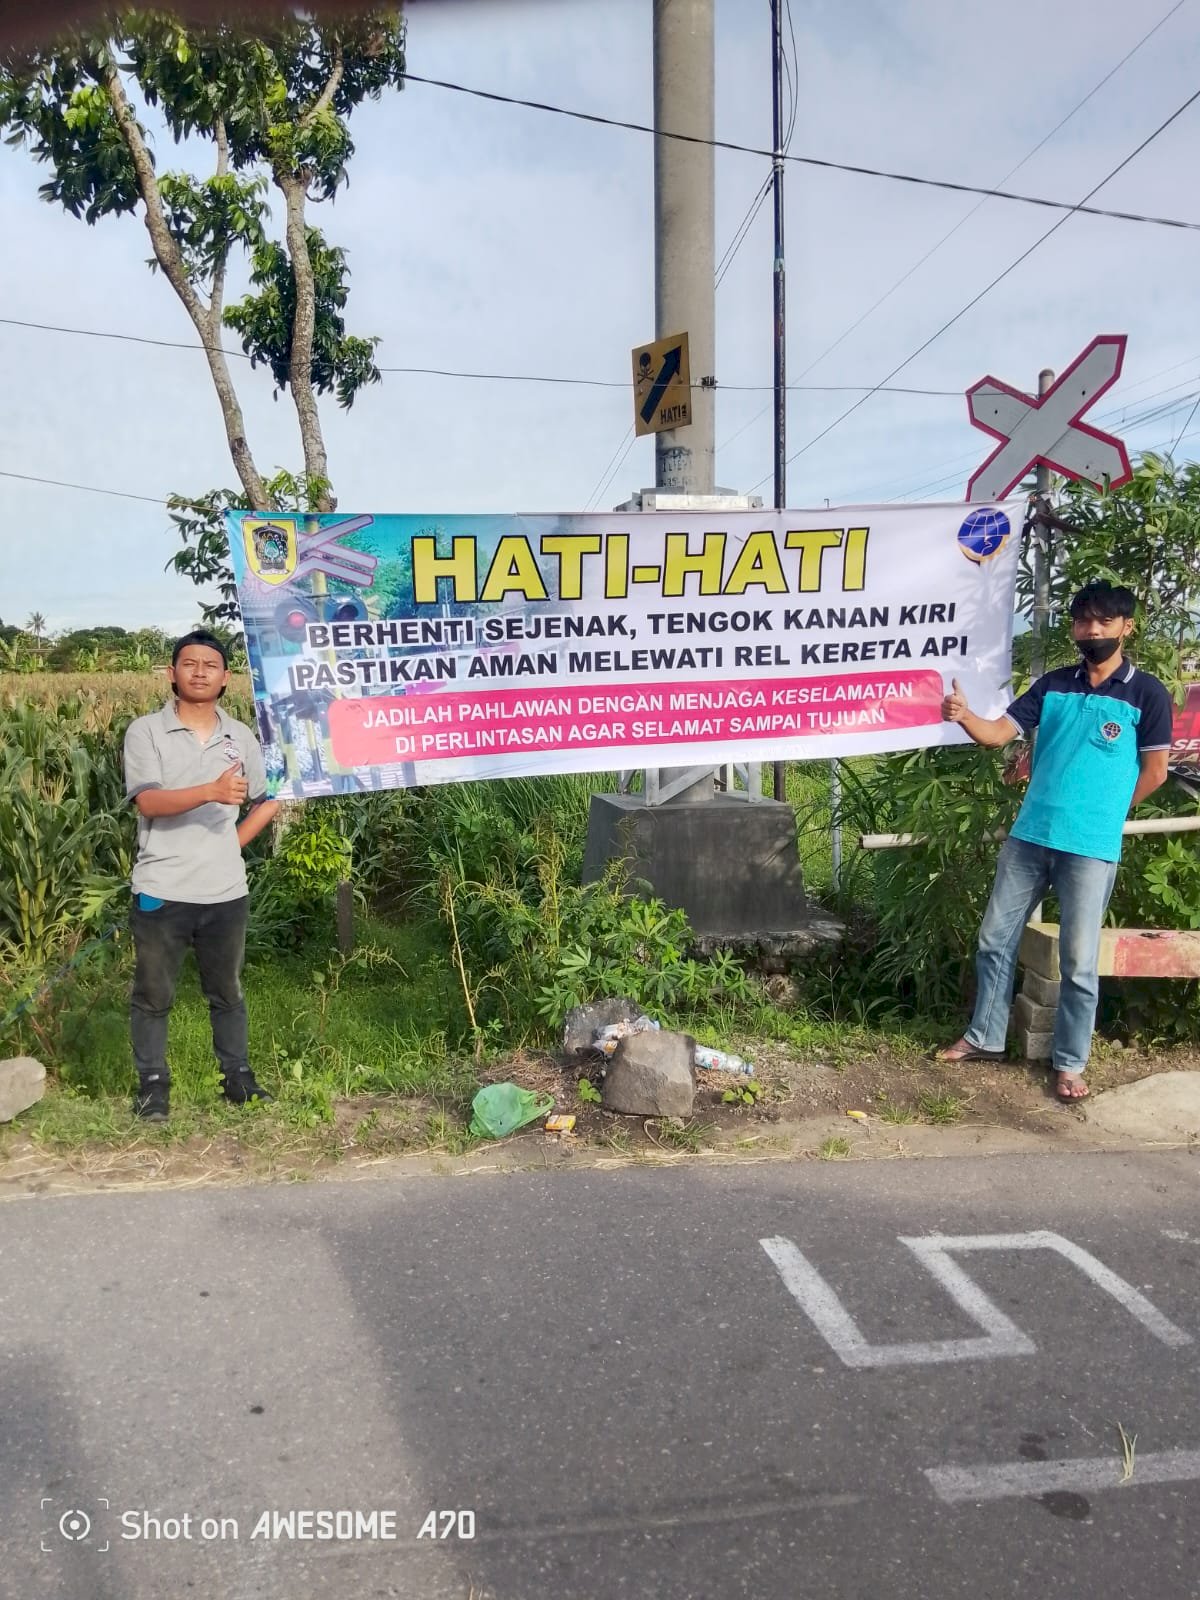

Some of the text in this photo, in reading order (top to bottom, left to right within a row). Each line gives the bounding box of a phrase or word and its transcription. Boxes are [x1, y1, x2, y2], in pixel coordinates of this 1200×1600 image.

[411, 526, 870, 604] HATI-HATI
[308, 602, 956, 649] BERHENTI SEJENAK, TENGOK KANAN KIRI
[296, 635, 968, 688] PASTIKAN AMAN MELEWATI REL KERETA API
[363, 682, 913, 729] JADILAH PAHLAWAN DENGAN MENJAGA KESELAMATAN
[395, 708, 886, 754] DI PERLINTASAN AGAR SELAMAT SAMPAI TUJUAN
